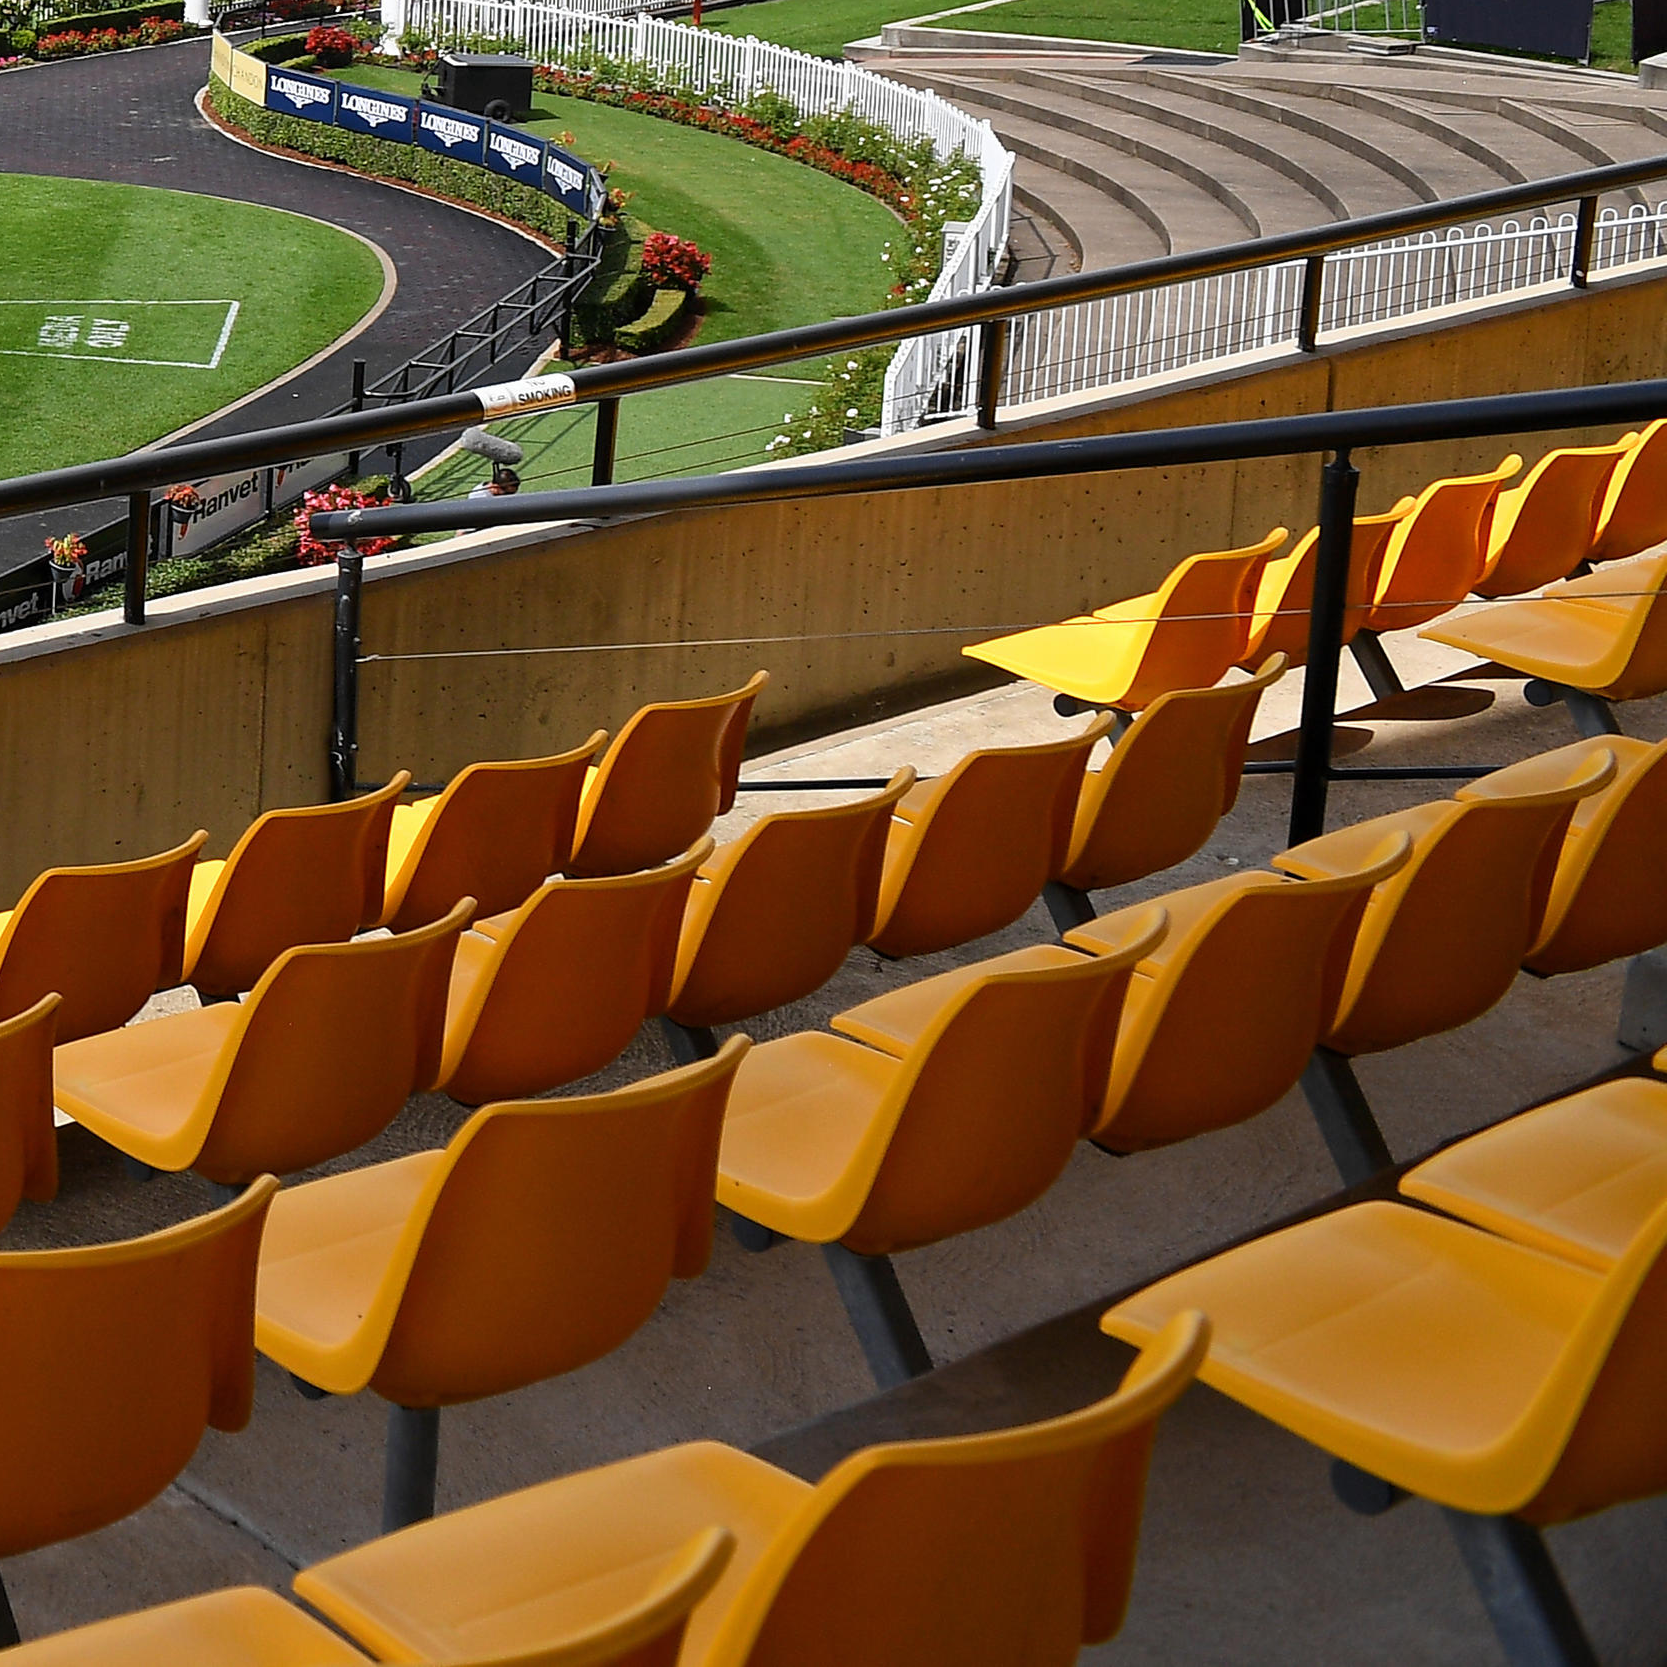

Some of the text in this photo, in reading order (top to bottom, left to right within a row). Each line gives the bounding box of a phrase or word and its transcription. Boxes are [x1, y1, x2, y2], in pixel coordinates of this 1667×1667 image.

[271, 75, 331, 104] LONGINES
[341, 93, 410, 122] LONGINES
[421, 112, 480, 143] LONGINES
[490, 132, 540, 166] LONGINES
[547, 155, 584, 191] LONGINES
[86, 318, 130, 348] ONLY
[518, 384, 571, 406] SMOKING
[193, 471, 259, 524] Ranvet
